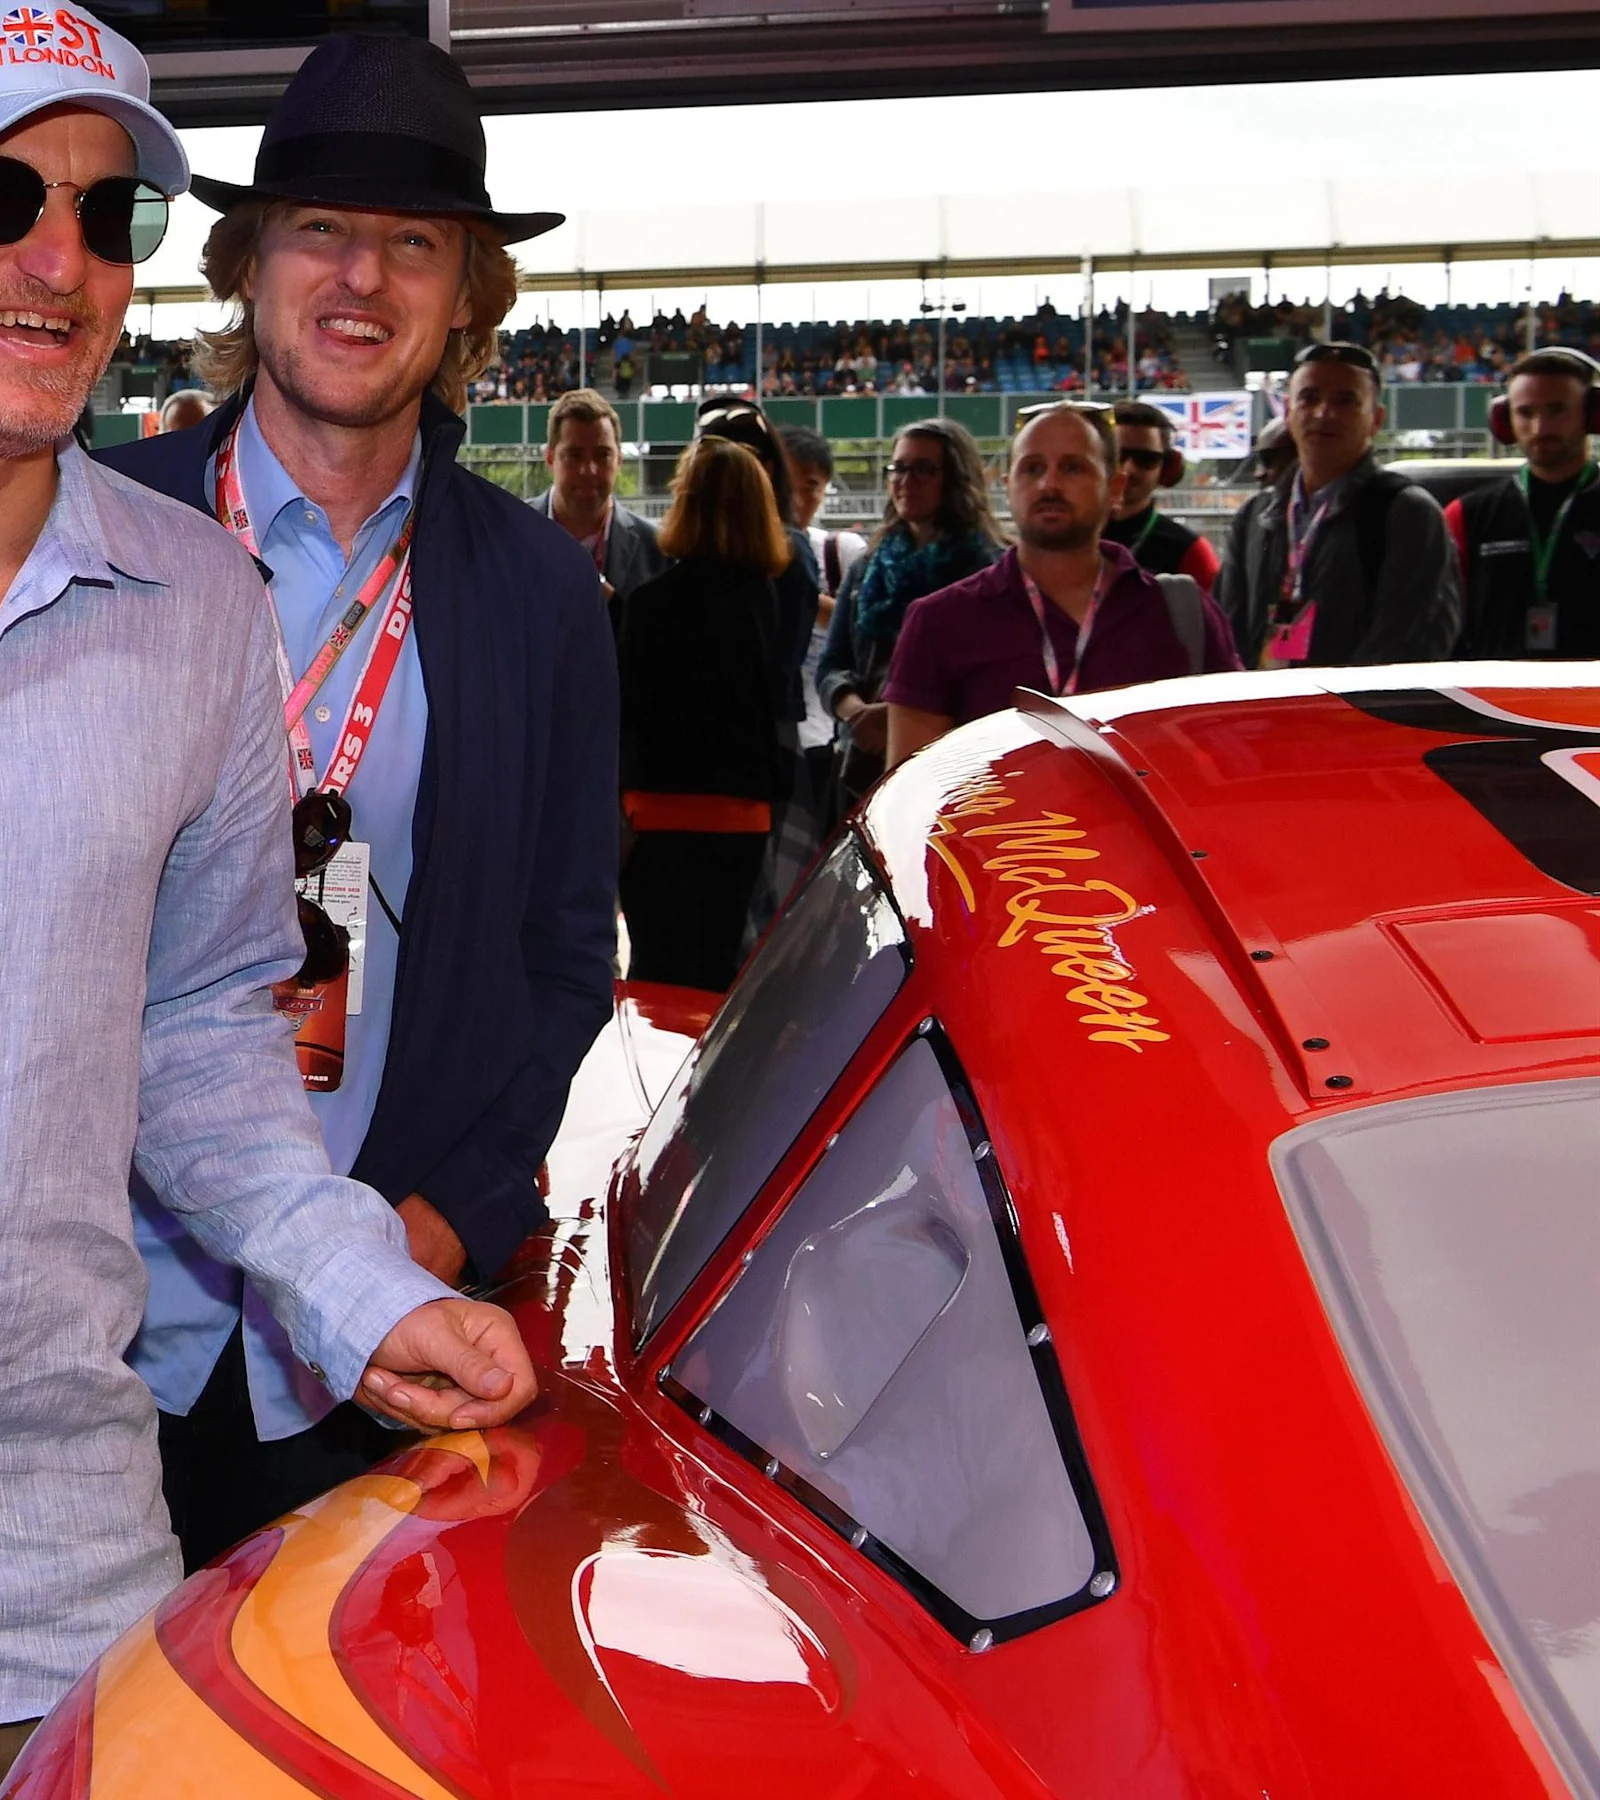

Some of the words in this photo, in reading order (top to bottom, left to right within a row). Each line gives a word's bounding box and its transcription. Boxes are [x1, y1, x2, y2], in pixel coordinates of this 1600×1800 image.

[9, 47, 116, 80] LONDON
[352, 701, 374, 728] 3
[962, 810, 1171, 1054] McQueen
[308, 1074, 329, 1082] PASS
